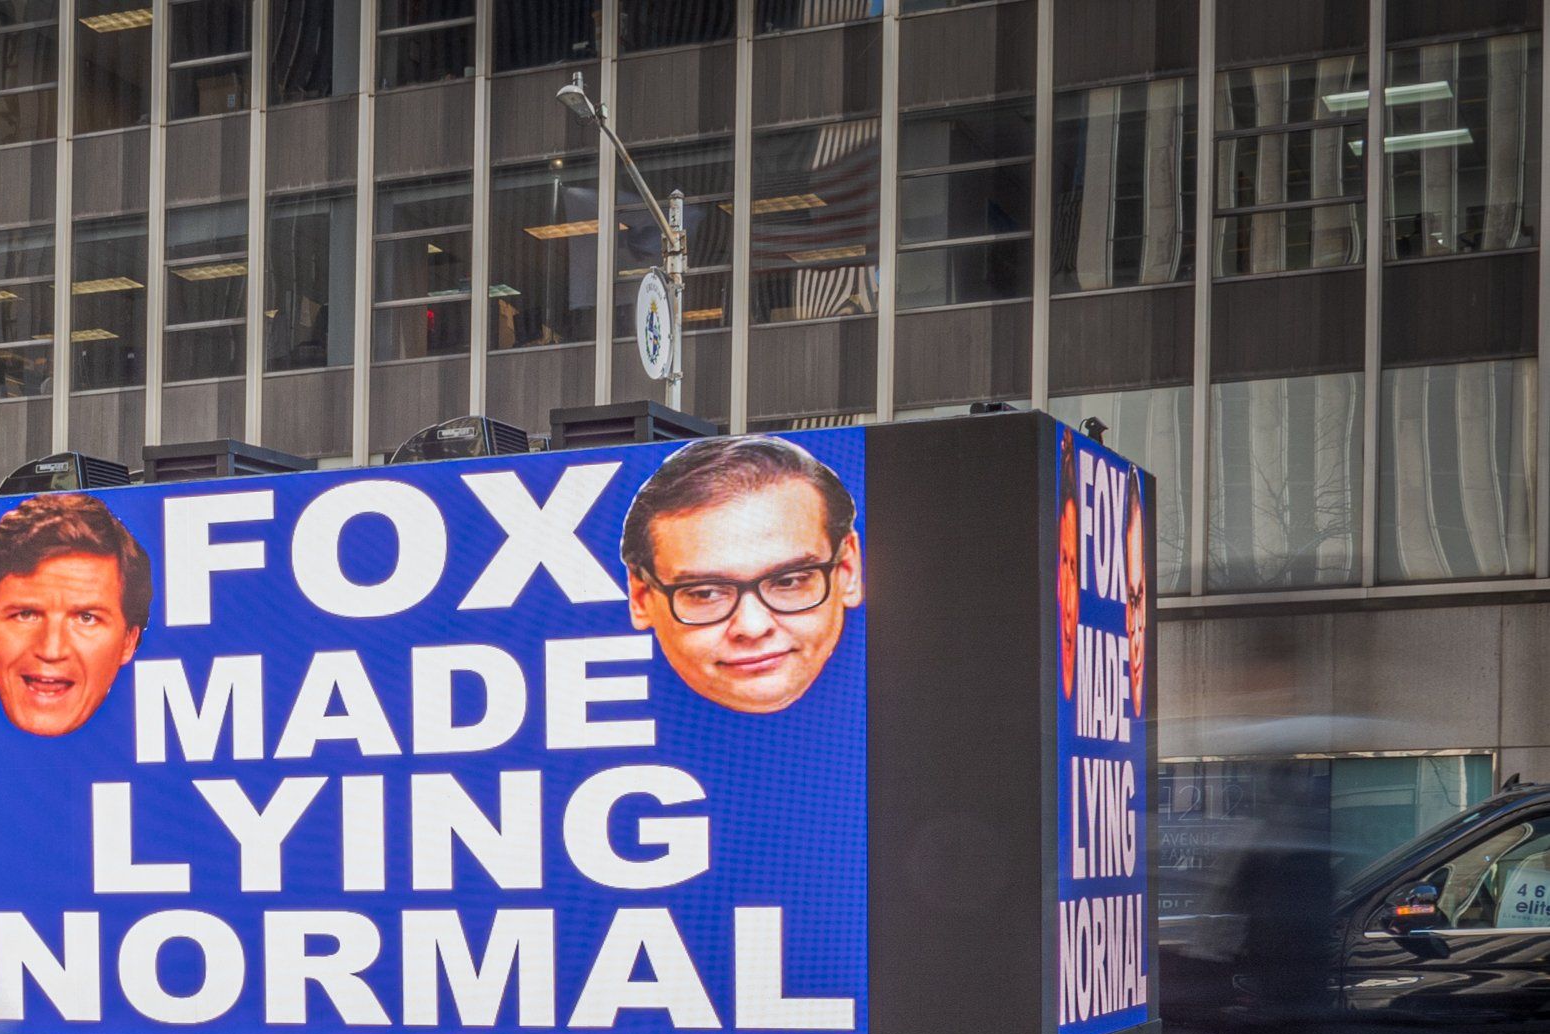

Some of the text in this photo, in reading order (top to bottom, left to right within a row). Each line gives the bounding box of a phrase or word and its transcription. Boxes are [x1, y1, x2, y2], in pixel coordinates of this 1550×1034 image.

[163, 461, 628, 627] FOX
[1079, 449, 1128, 604] FOX
[134, 634, 656, 764] MADE
[1077, 624, 1130, 743] MADE
[91, 764, 710, 893] LYING
[1071, 756, 1136, 880] LYING
[1161, 832, 1219, 846] AVENUE
[1059, 893, 1147, 1026] NORMAL
